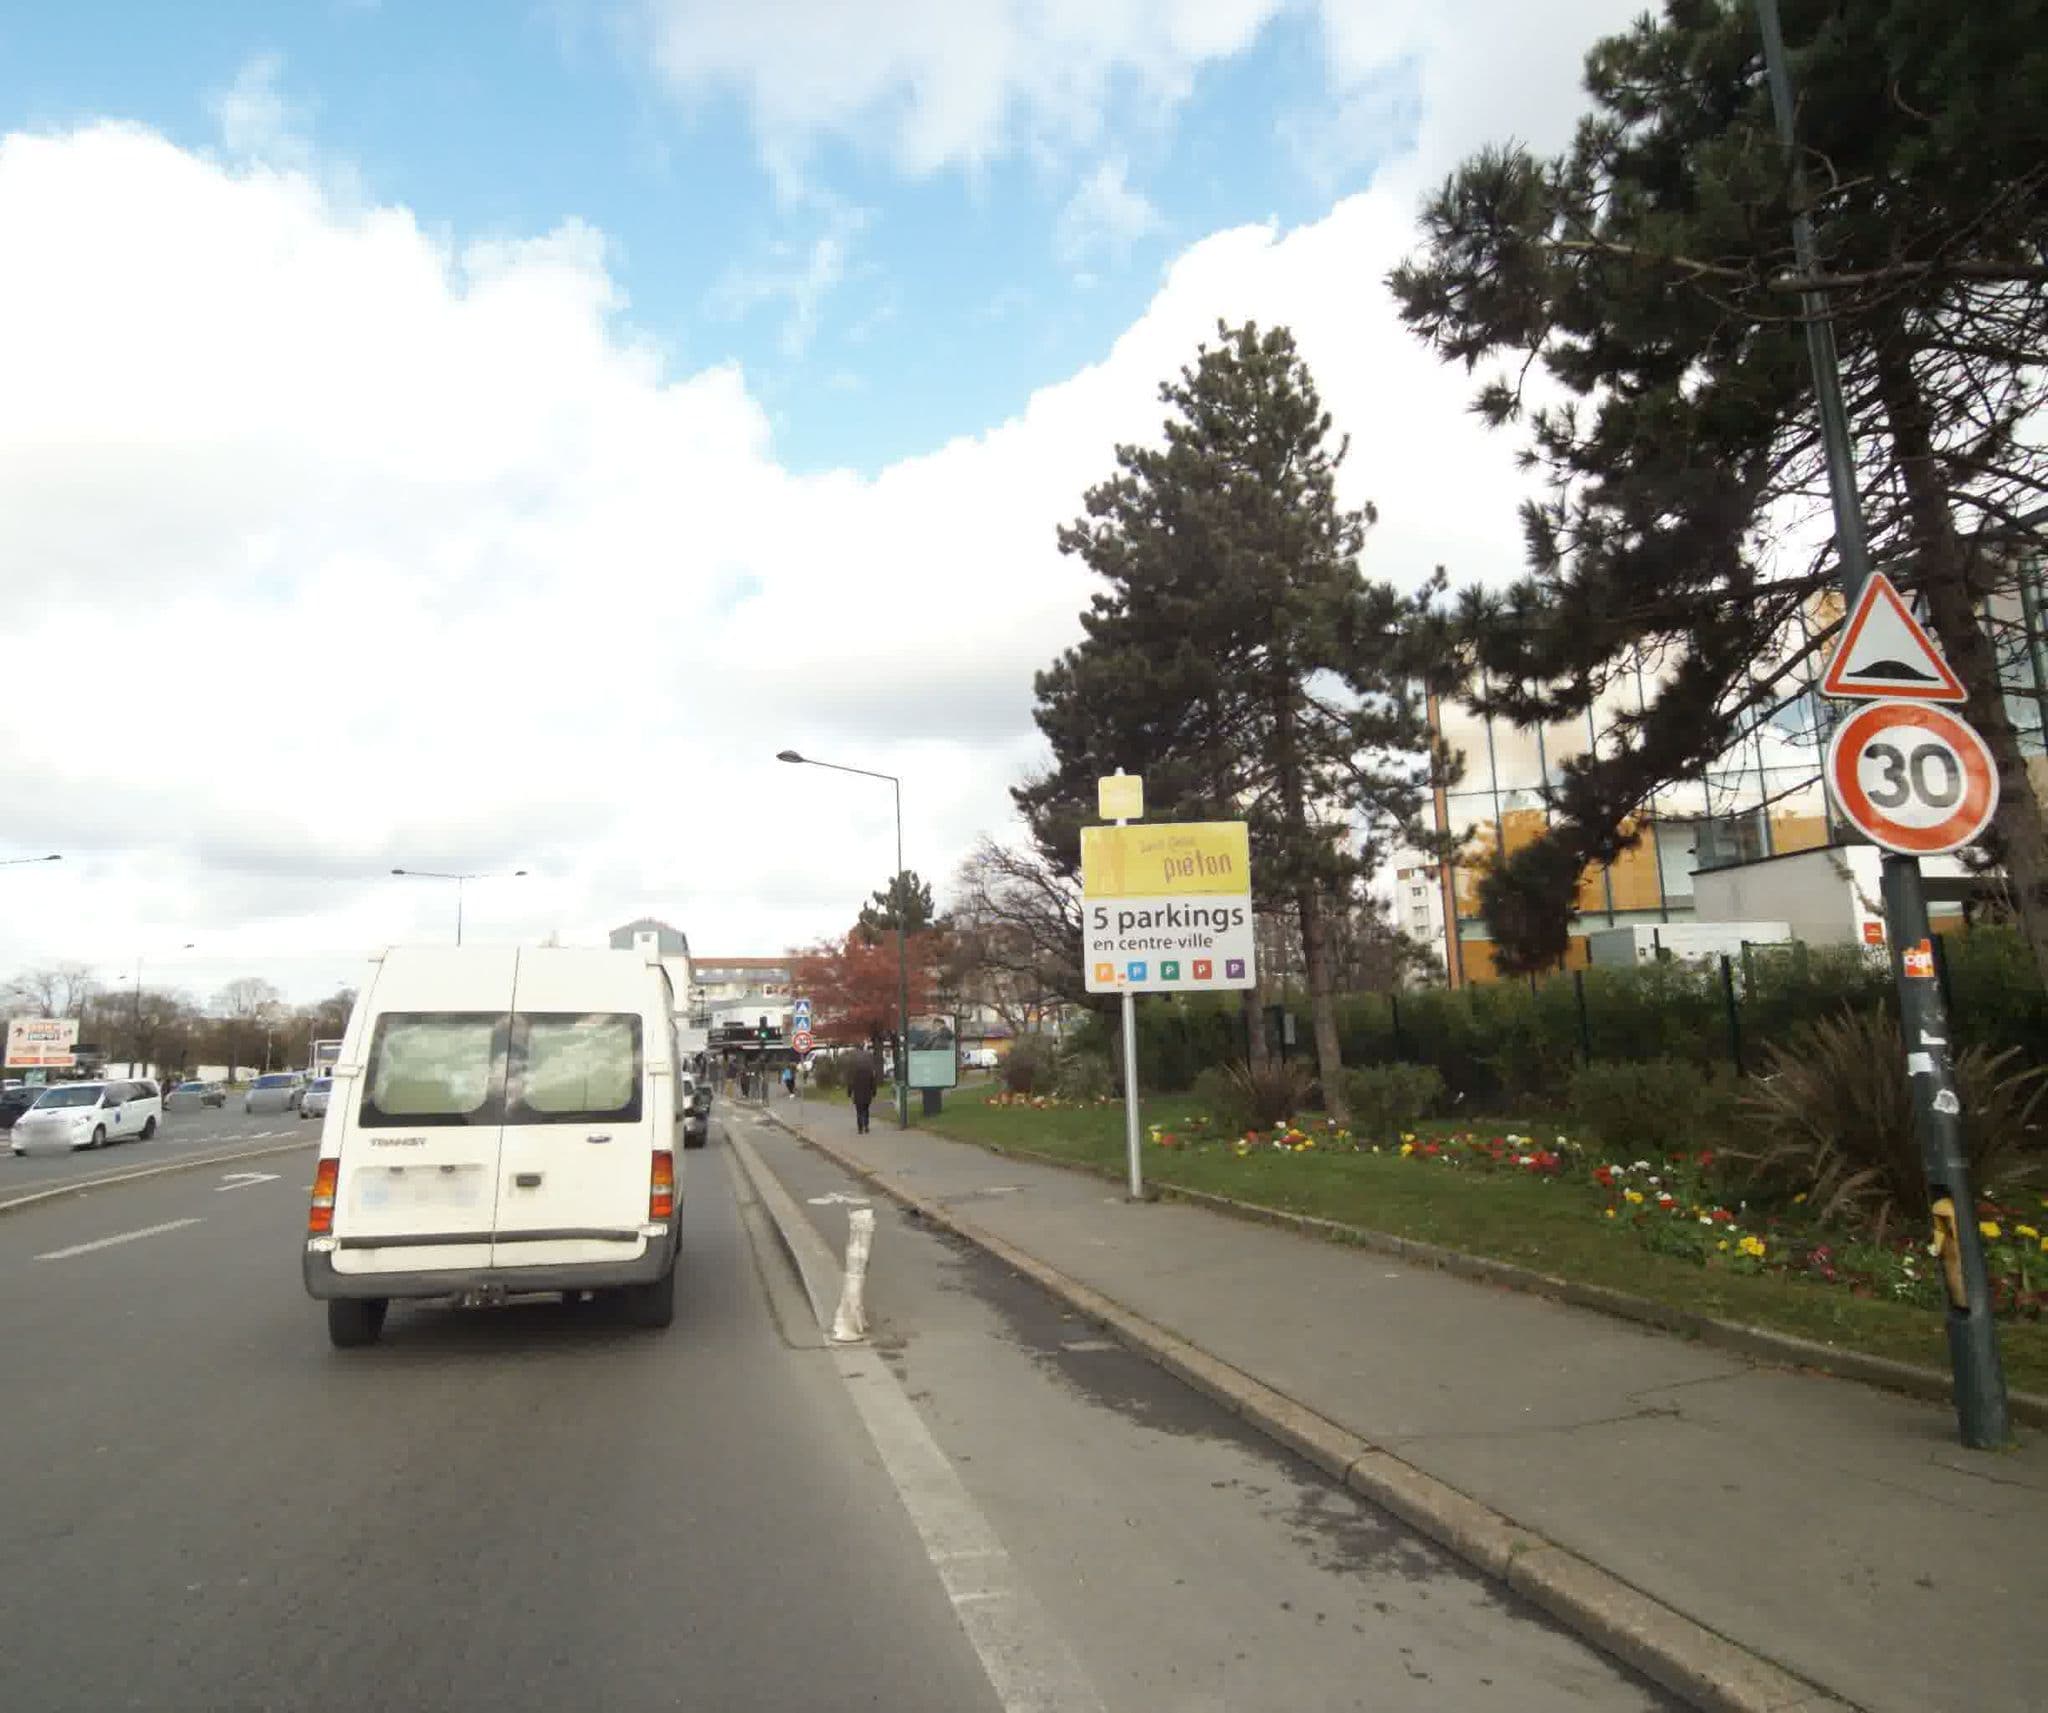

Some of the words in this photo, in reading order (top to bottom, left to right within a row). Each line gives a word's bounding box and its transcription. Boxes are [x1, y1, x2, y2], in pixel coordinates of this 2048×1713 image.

[1864, 743, 1961, 808] 30
[1094, 907, 1108, 930] 5
[1118, 903, 1244, 935] parkings
[1093, 939, 1114, 951] en
[1119, 933, 1213, 951] centre-ville
